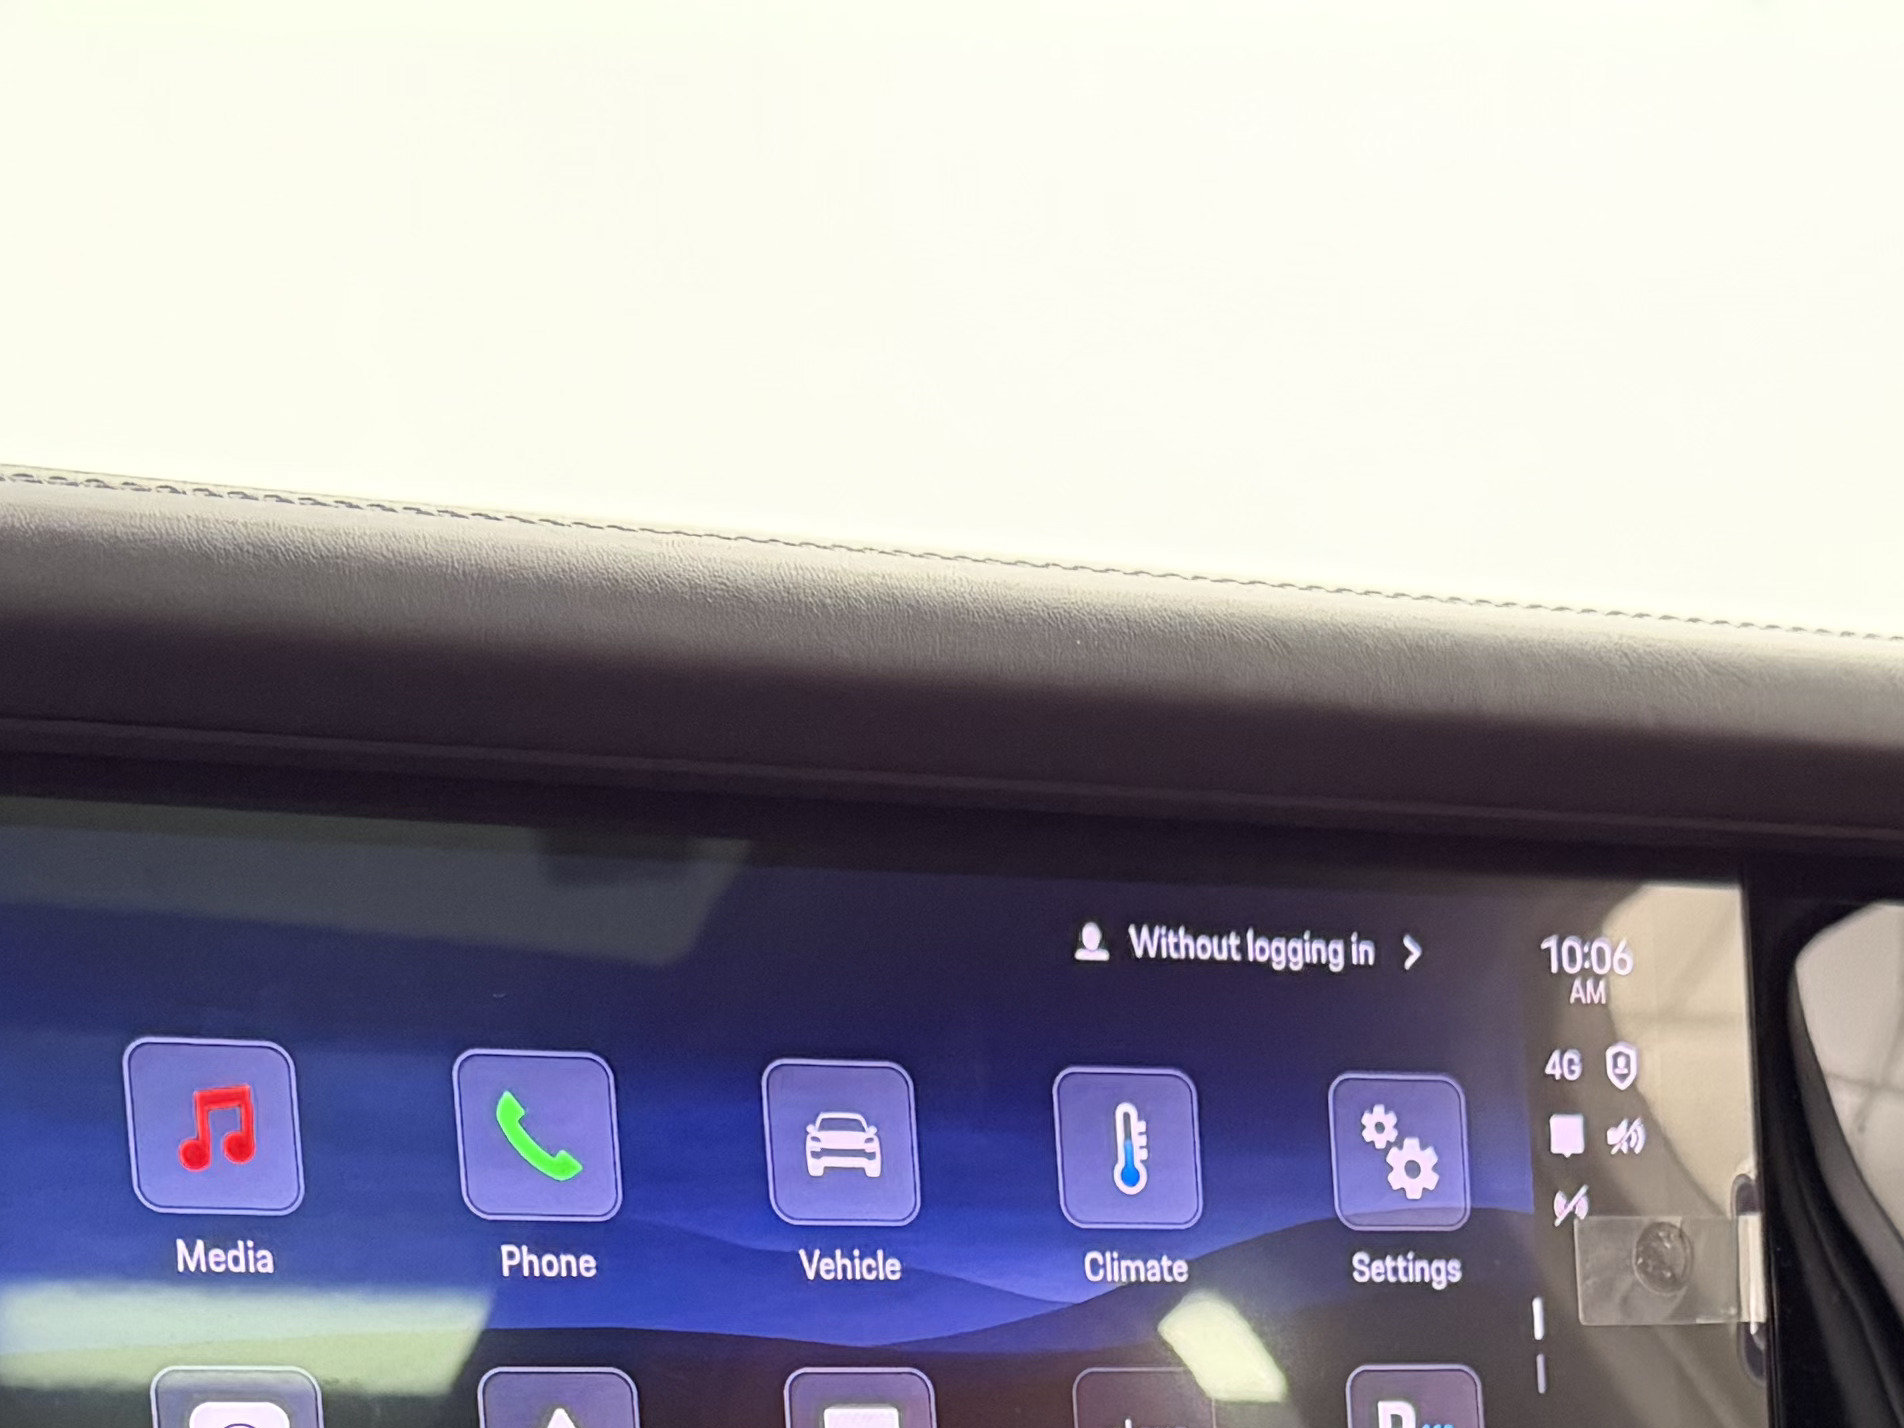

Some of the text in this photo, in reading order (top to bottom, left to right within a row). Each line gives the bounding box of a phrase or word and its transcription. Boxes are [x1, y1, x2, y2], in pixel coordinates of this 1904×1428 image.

[1129, 925, 1374, 968] Without logging in
[1540, 934, 1634, 976] 10:06
[1569, 977, 1606, 1004] AM
[1545, 1049, 1583, 1081] 4G
[177, 1239, 273, 1273] Media
[501, 1245, 596, 1277] Phone
[799, 1249, 901, 1280] Vehicle
[1085, 1252, 1188, 1282] Climate
[1353, 1252, 1461, 1290] Settings
